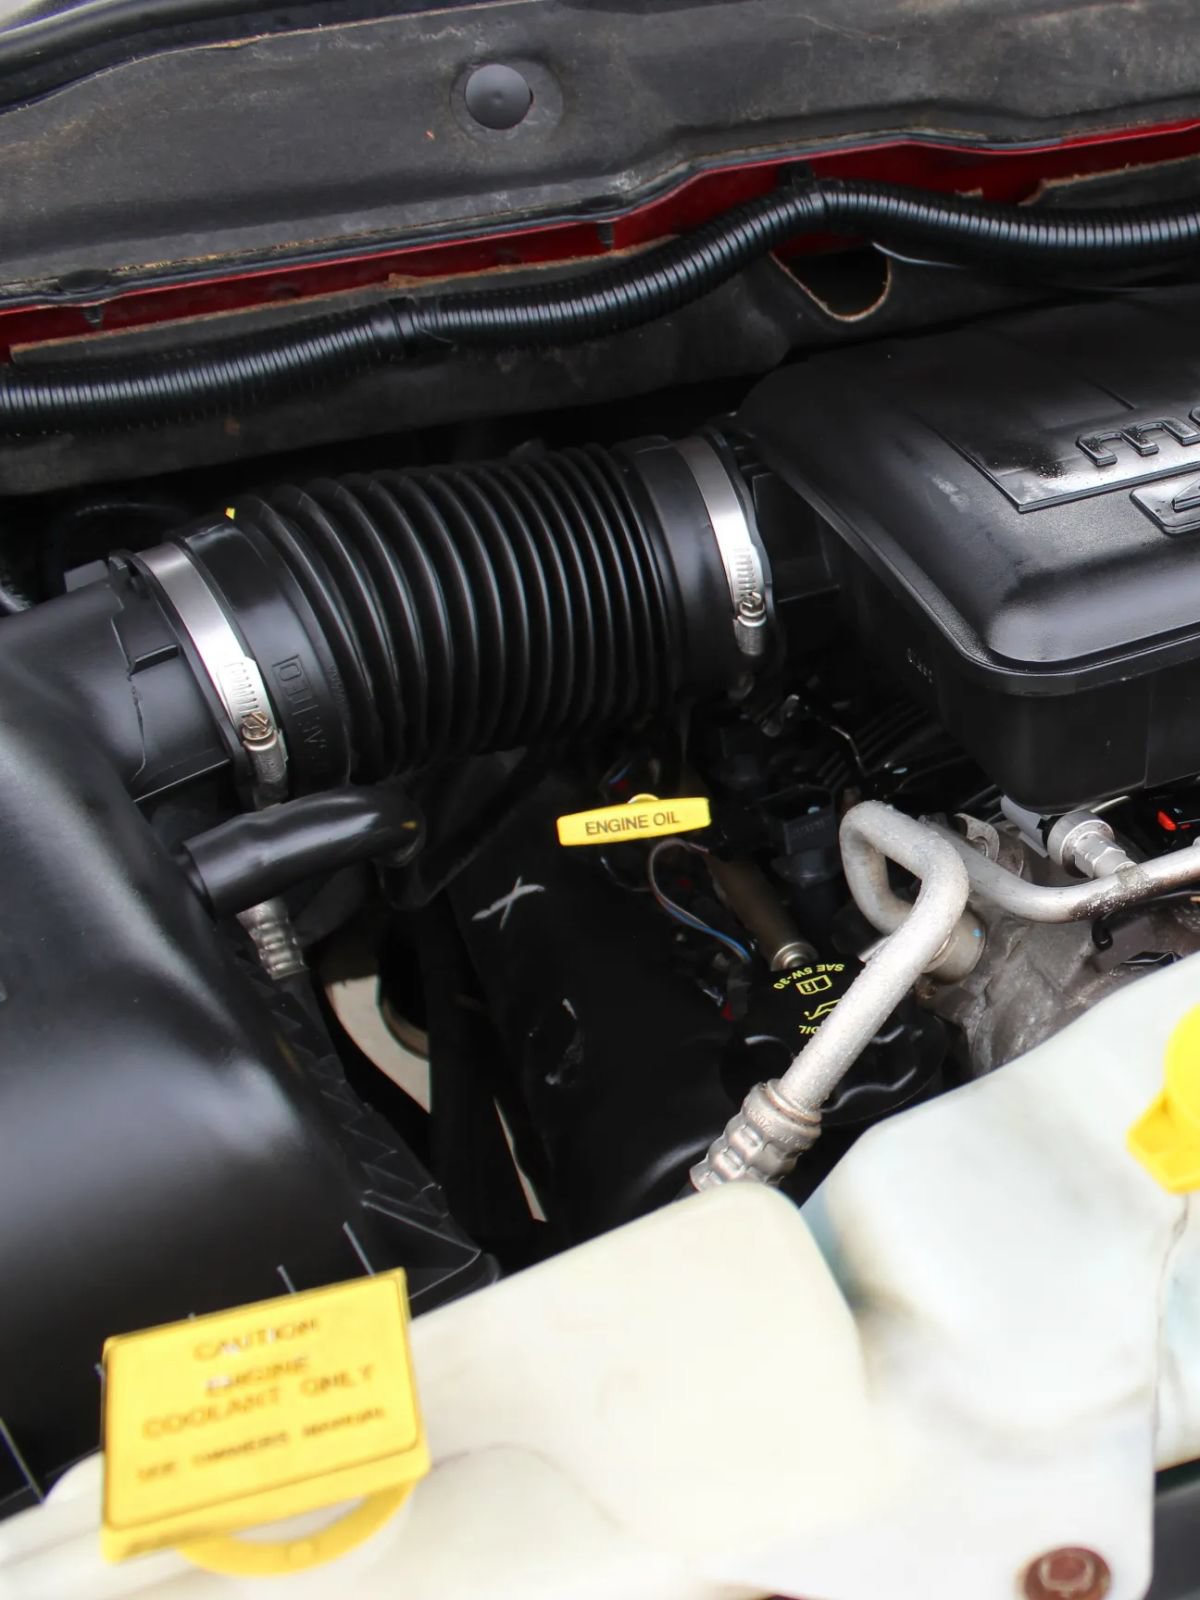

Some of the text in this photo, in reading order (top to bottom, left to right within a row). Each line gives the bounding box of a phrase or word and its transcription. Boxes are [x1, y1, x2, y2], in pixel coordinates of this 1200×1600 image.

[585, 811, 680, 836] ENGINE OIL
[773, 963, 845, 990] SAE 5W-30
[195, 1318, 318, 1360] CAUTION
[205, 1357, 309, 1397] ENGINE
[142, 1365, 375, 1438] COOLANT ONLY
